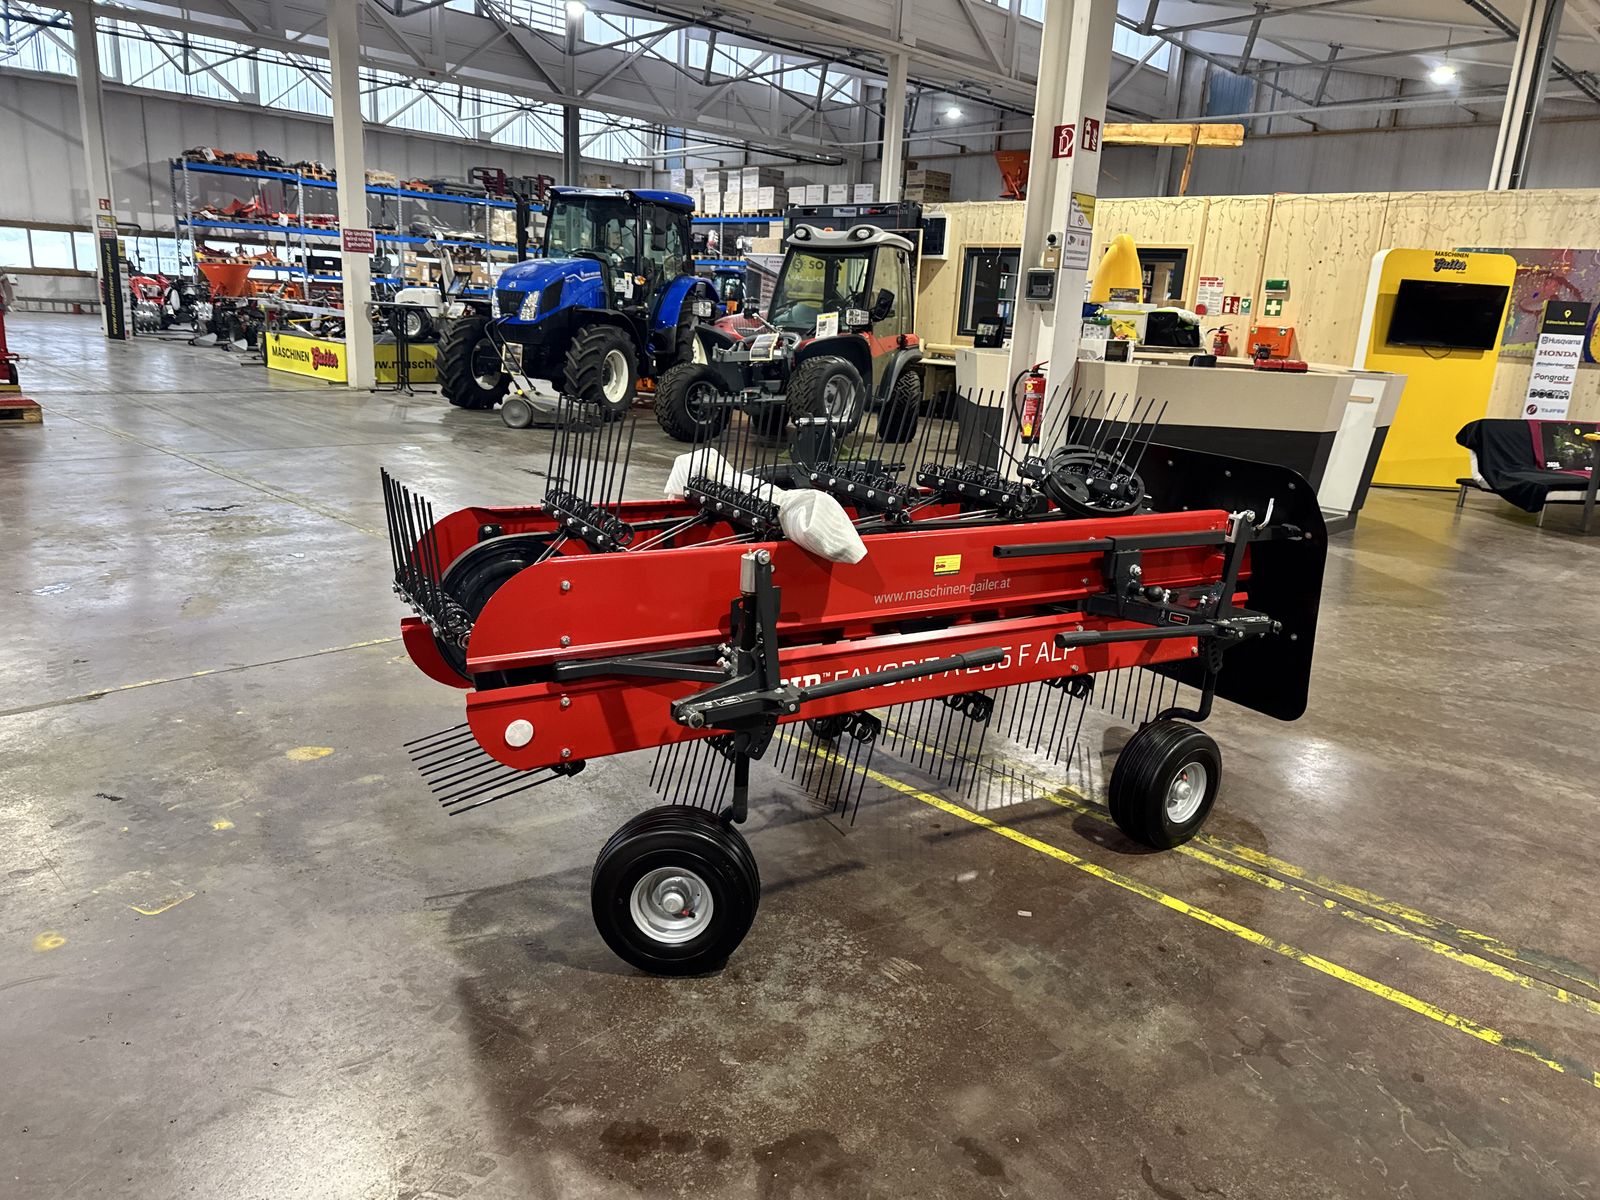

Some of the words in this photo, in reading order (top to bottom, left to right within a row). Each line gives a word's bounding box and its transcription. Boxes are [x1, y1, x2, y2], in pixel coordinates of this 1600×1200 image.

[1548, 337, 1582, 346] Husqvarna
[272, 345, 310, 363] MASCHINEN
[1538, 350, 1578, 358] HONDA
[1534, 373, 1569, 383] Pongratz
[1529, 388, 1570, 400] DOCMA
[874, 578, 1011, 605] www.maschinen-gailer.at
[1018, 643, 1032, 667] F
